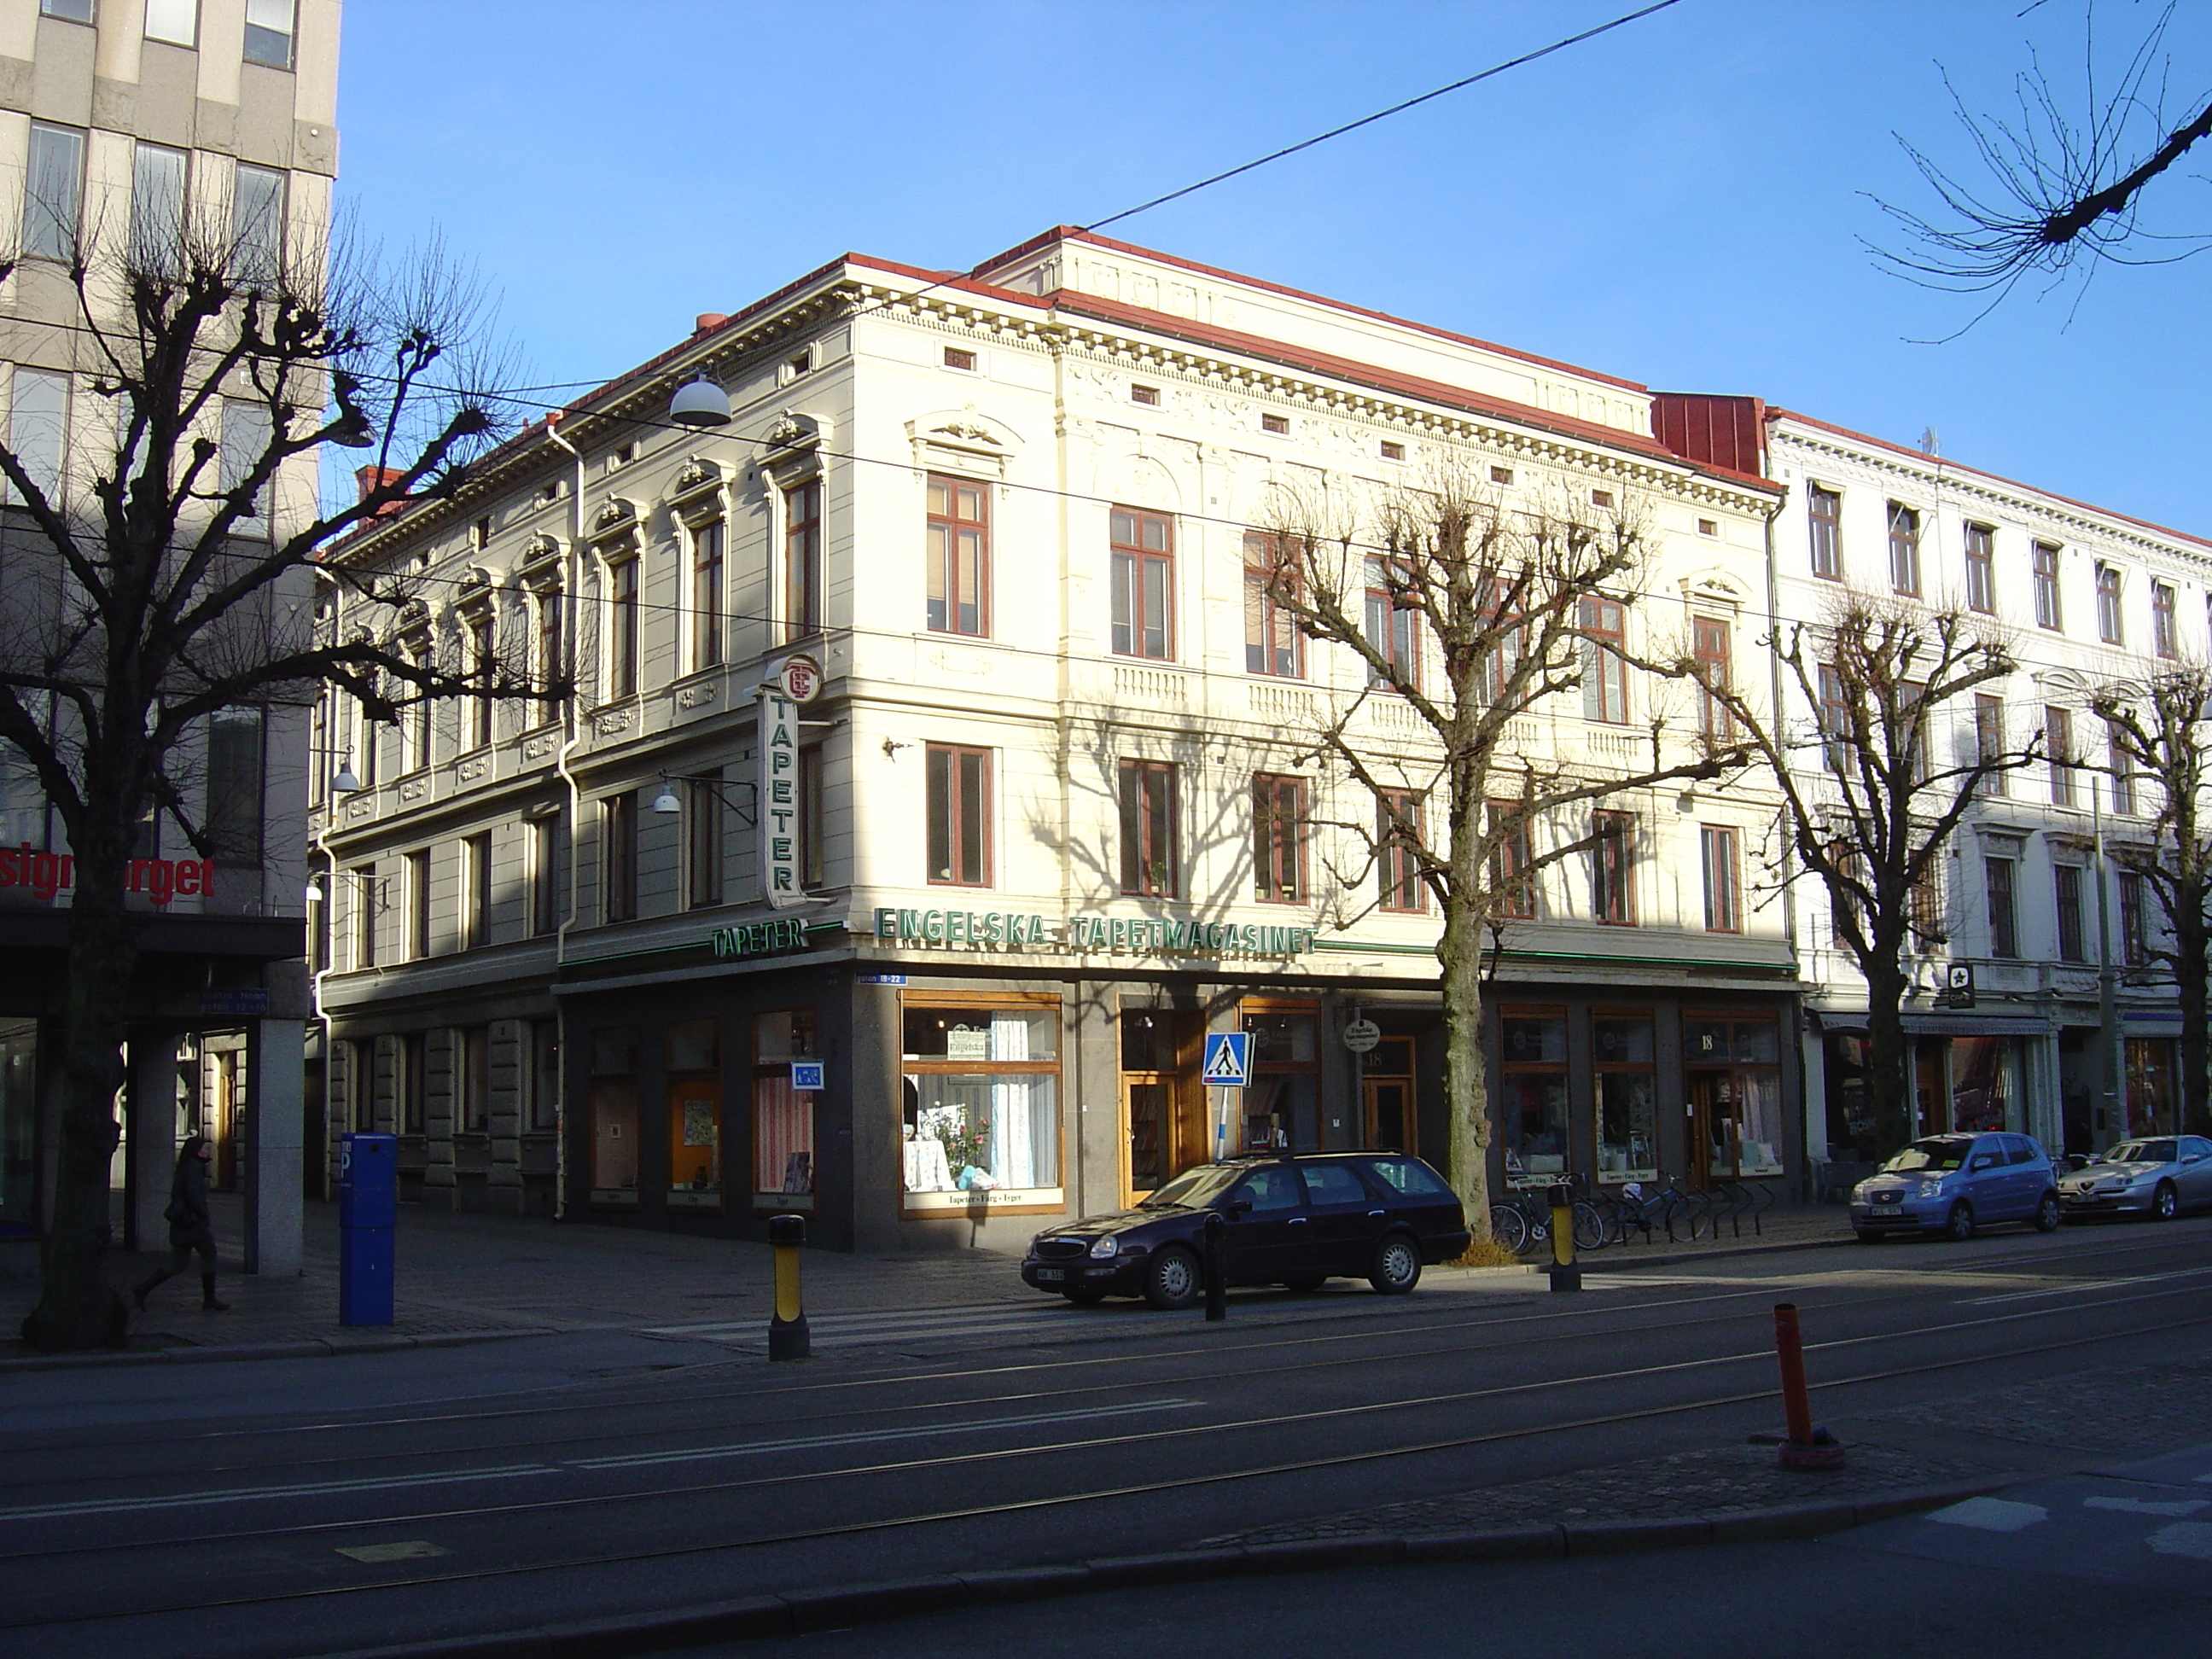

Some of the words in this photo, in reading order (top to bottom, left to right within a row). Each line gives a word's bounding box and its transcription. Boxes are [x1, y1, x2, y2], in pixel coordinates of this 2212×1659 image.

[770, 696, 794, 892] TAPETER
[0, 842, 216, 905] signrget
[711, 918, 810, 958] TAPETER
[873, 907, 1047, 945] ENGELSKA
[1068, 917, 1319, 955] TAPETMAGASINET
[1369, 1052, 1382, 1067] 18
[1702, 1034, 1713, 1051] 18
